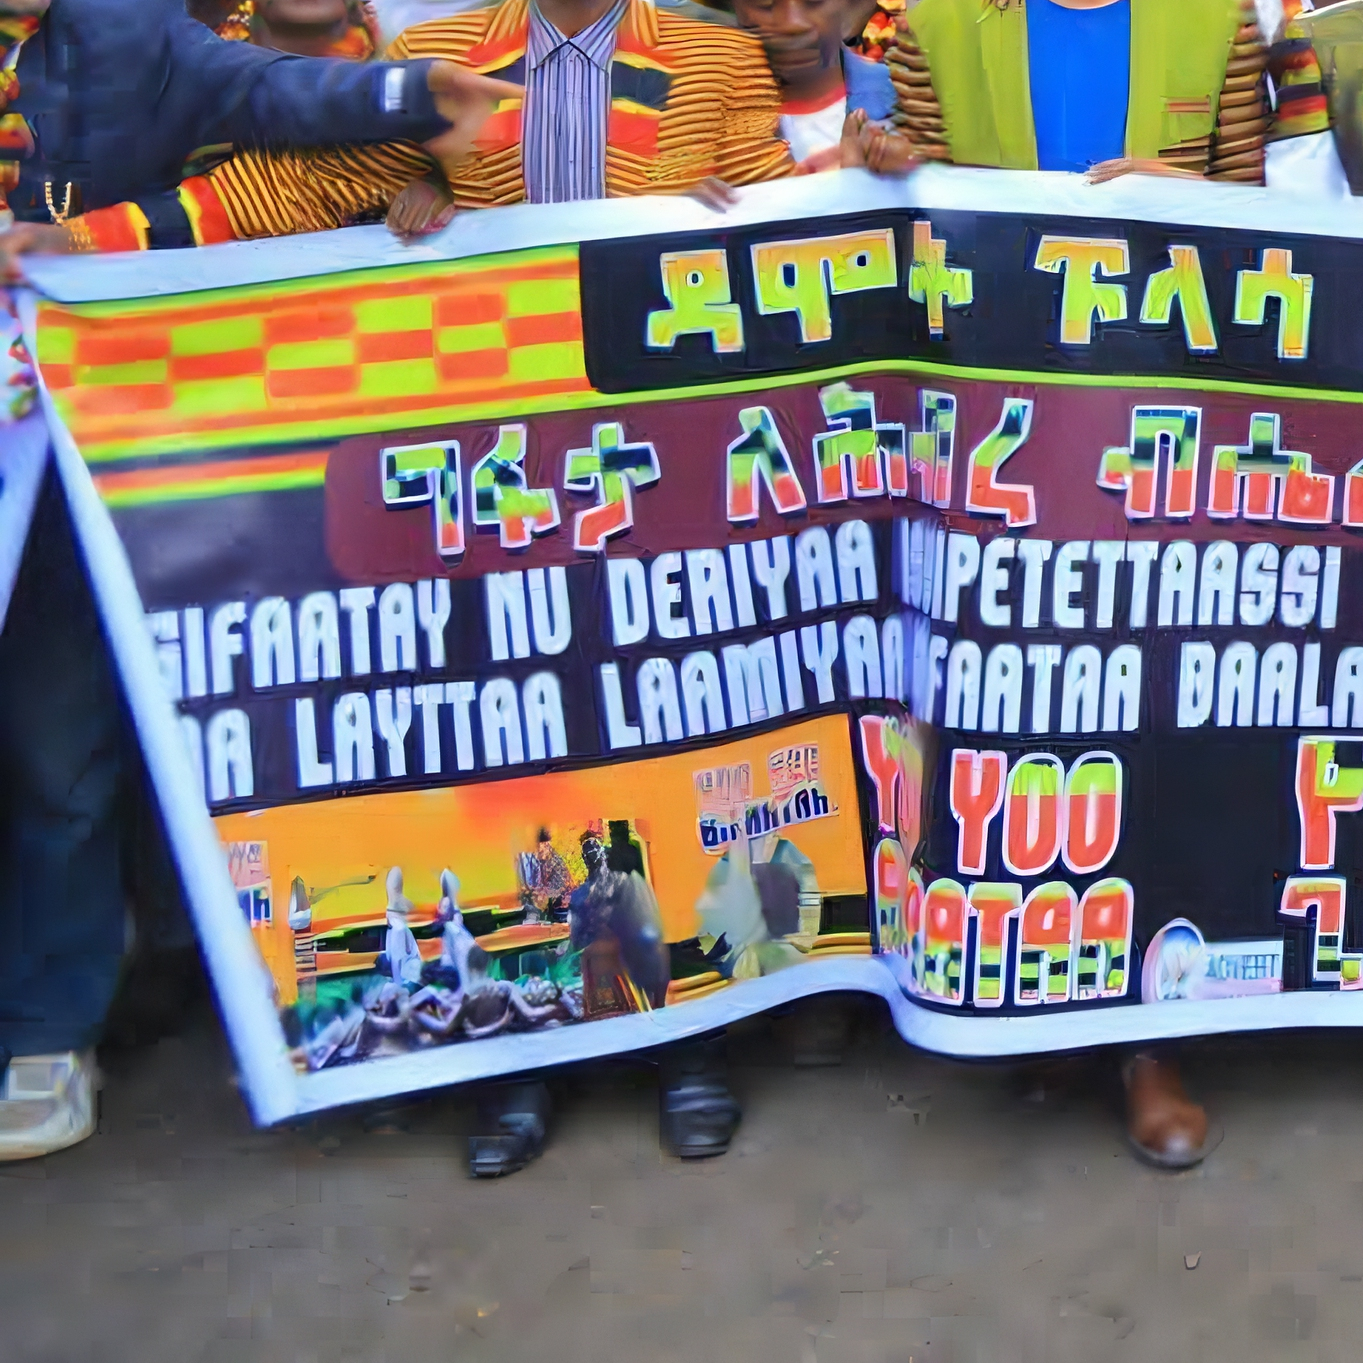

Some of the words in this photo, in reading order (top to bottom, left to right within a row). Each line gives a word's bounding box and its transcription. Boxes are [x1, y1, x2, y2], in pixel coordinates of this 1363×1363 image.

[485, 566, 572, 660] NU
[295, 671, 568, 788] LAYTTAA
[950, 748, 1123, 876] YOO
